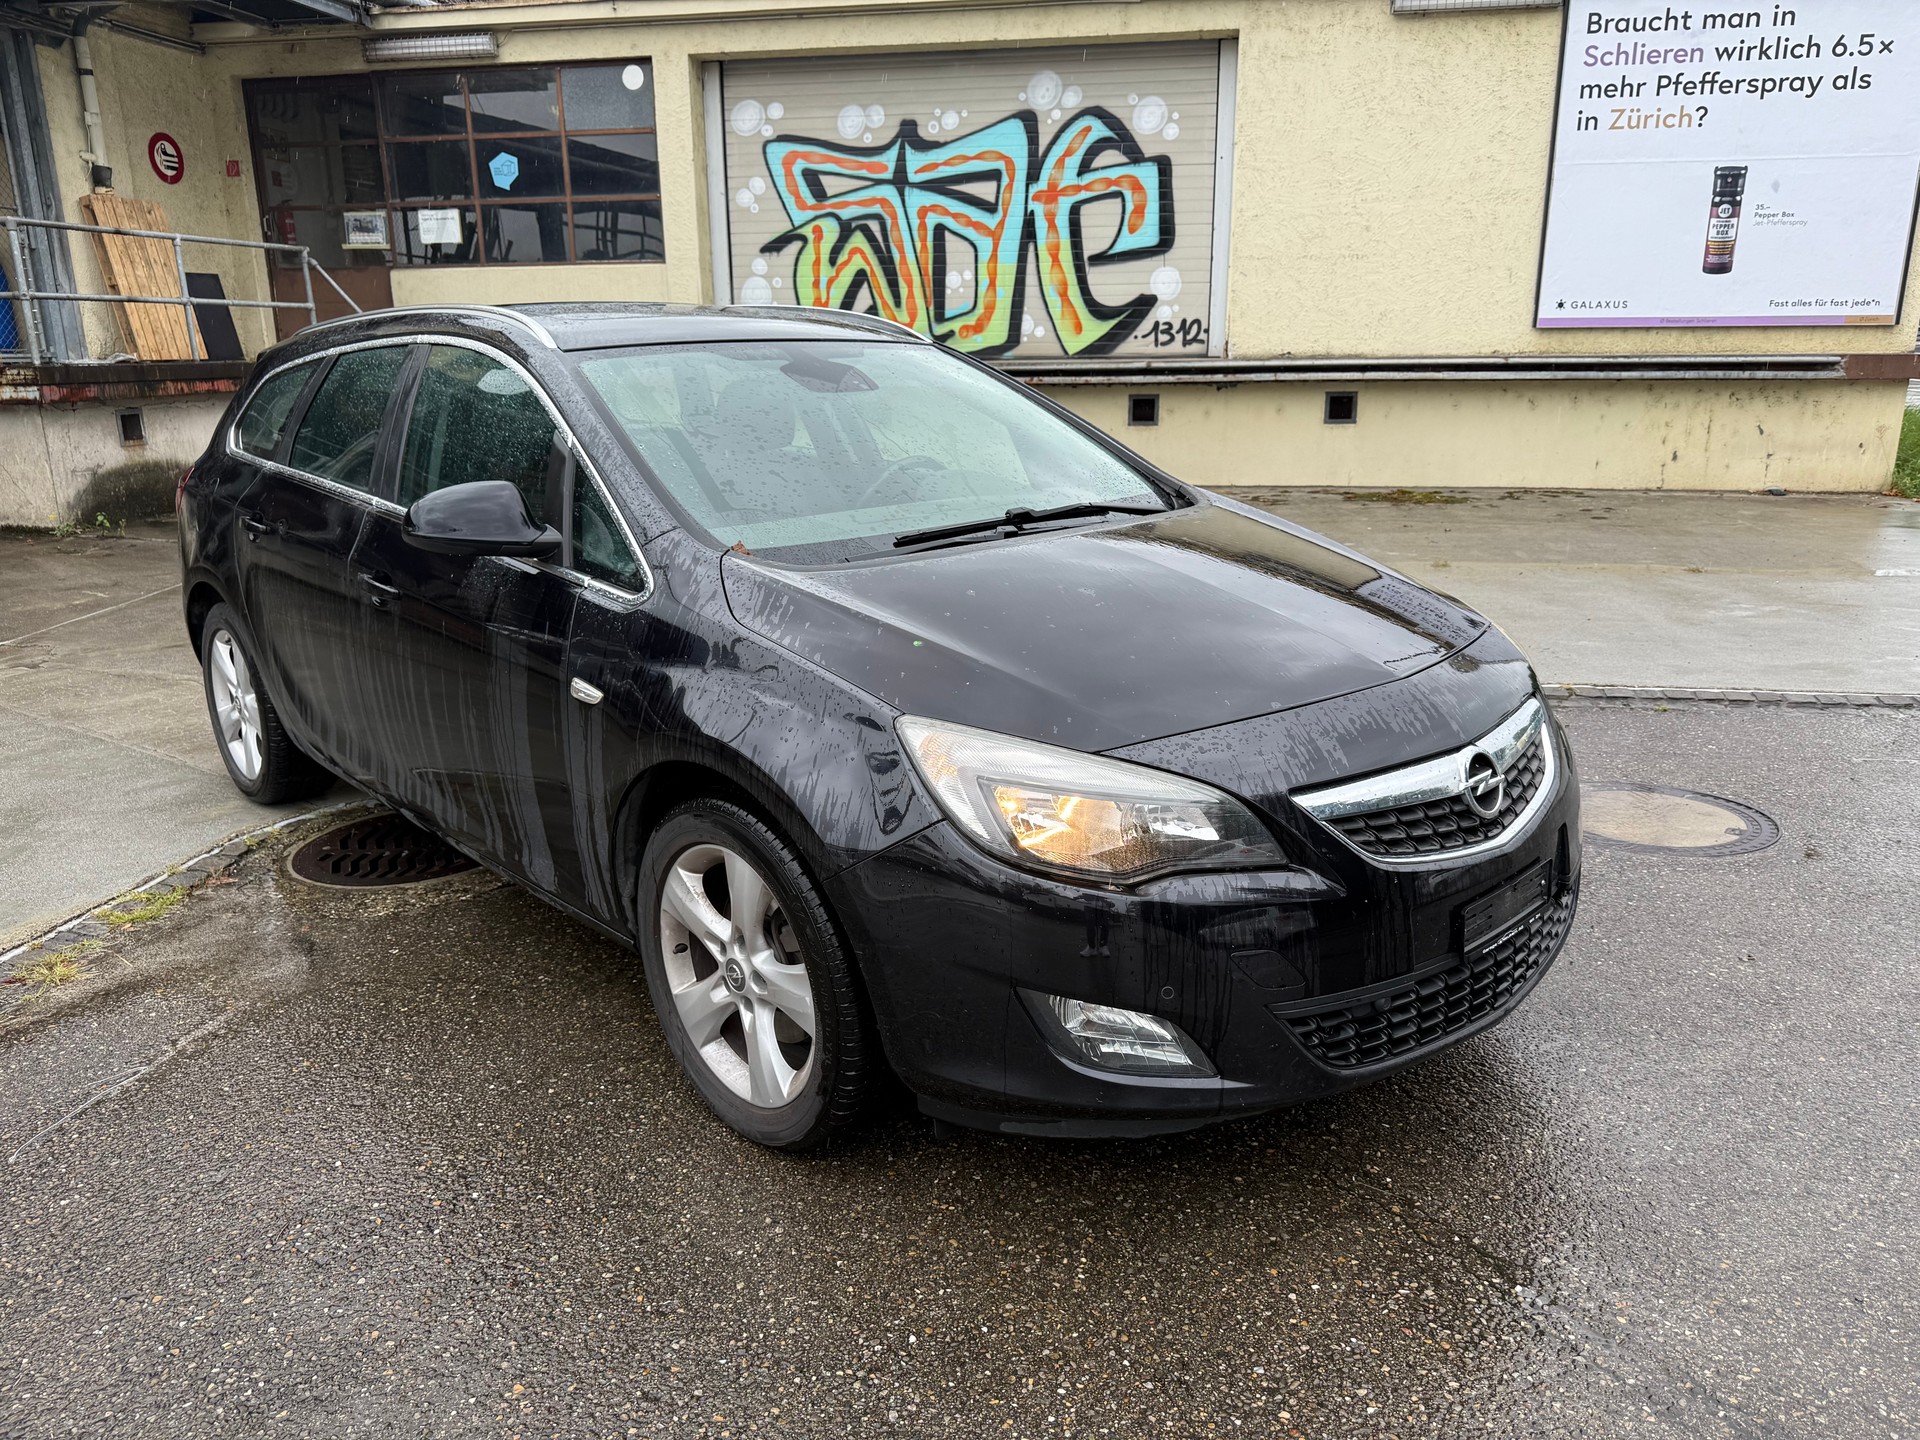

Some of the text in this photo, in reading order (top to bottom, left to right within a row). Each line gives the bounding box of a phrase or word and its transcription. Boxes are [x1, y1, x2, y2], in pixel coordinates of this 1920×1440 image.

[1587, 4, 1796, 34] Braucht man in
[1583, 42, 1704, 67] Schlieren
[1714, 34, 1821, 62] wirklich
[1579, 66, 1872, 100] mehr Pfefferspray als
[1577, 105, 1708, 131] in Zürich?
[1719, 207, 1731, 215] JET
[1570, 300, 1628, 309] GALAXUS
[1769, 299, 1788, 307] Fast
[1791, 299, 1812, 307] alles
[1814, 299, 1828, 307] für
[1830, 299, 1848, 307] fast
